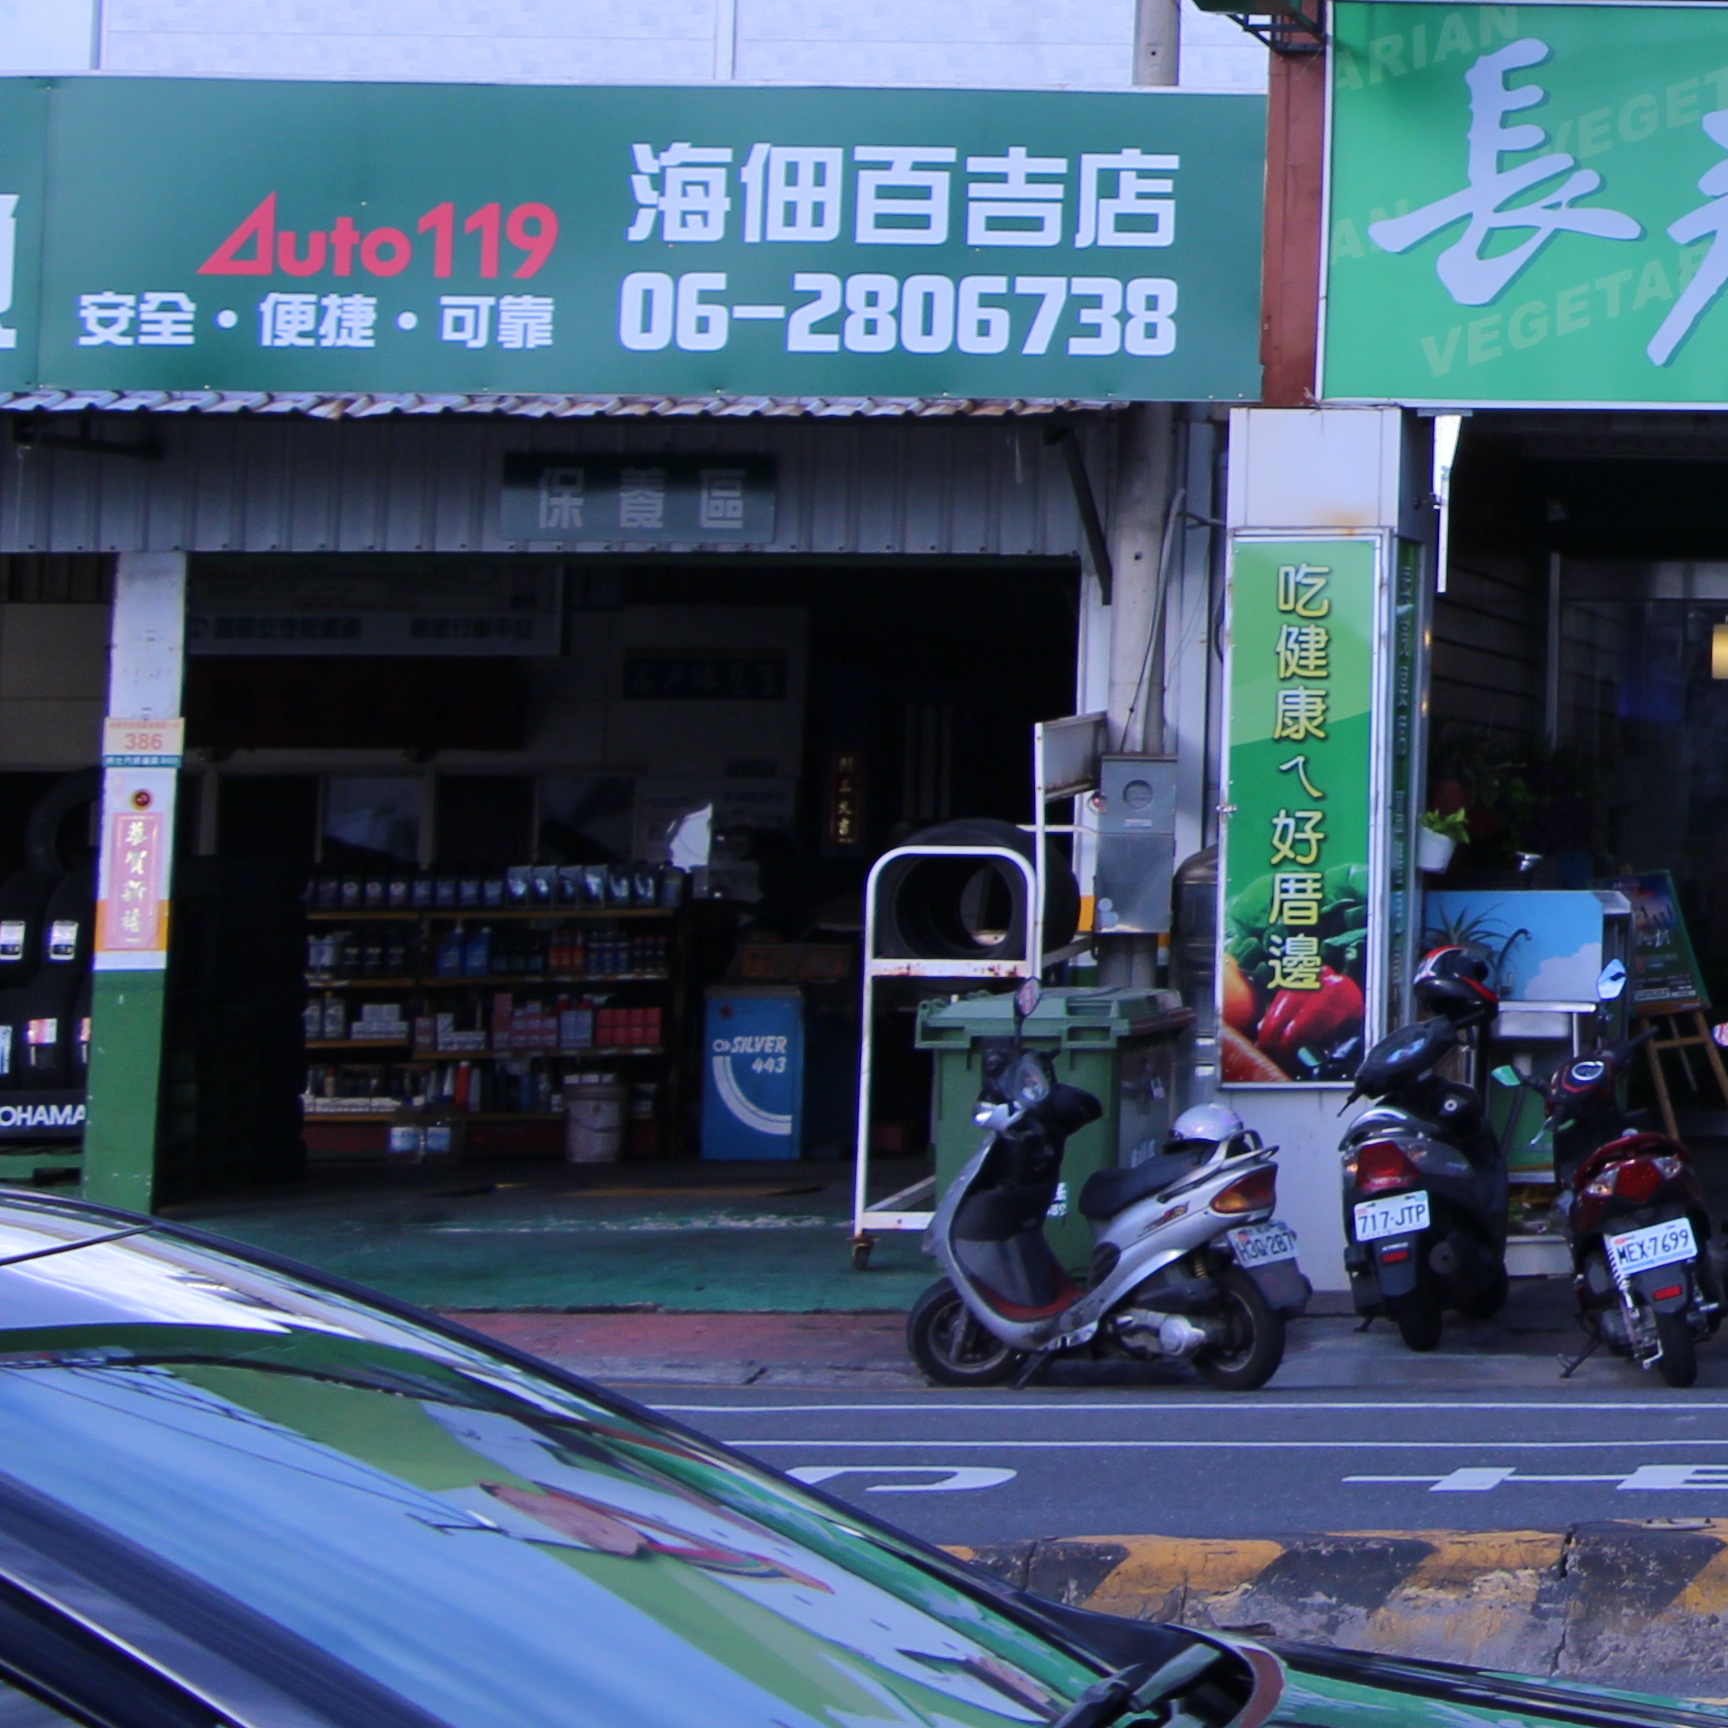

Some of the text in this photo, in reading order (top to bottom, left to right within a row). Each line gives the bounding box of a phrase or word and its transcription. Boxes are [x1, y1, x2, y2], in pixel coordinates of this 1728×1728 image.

[627, 141, 1180, 249] 海佃百吉店
[619, 272, 1179, 356] 06-2806738
[538, 465, 746, 531] 保養區
[125, 733, 163, 751] 386
[730, 1035, 788, 1054] SILVER
[752, 1056, 787, 1074] 443
[1358, 1203, 1426, 1234] 717-JTP
[1616, 1228, 1689, 1266] MEX-7699
